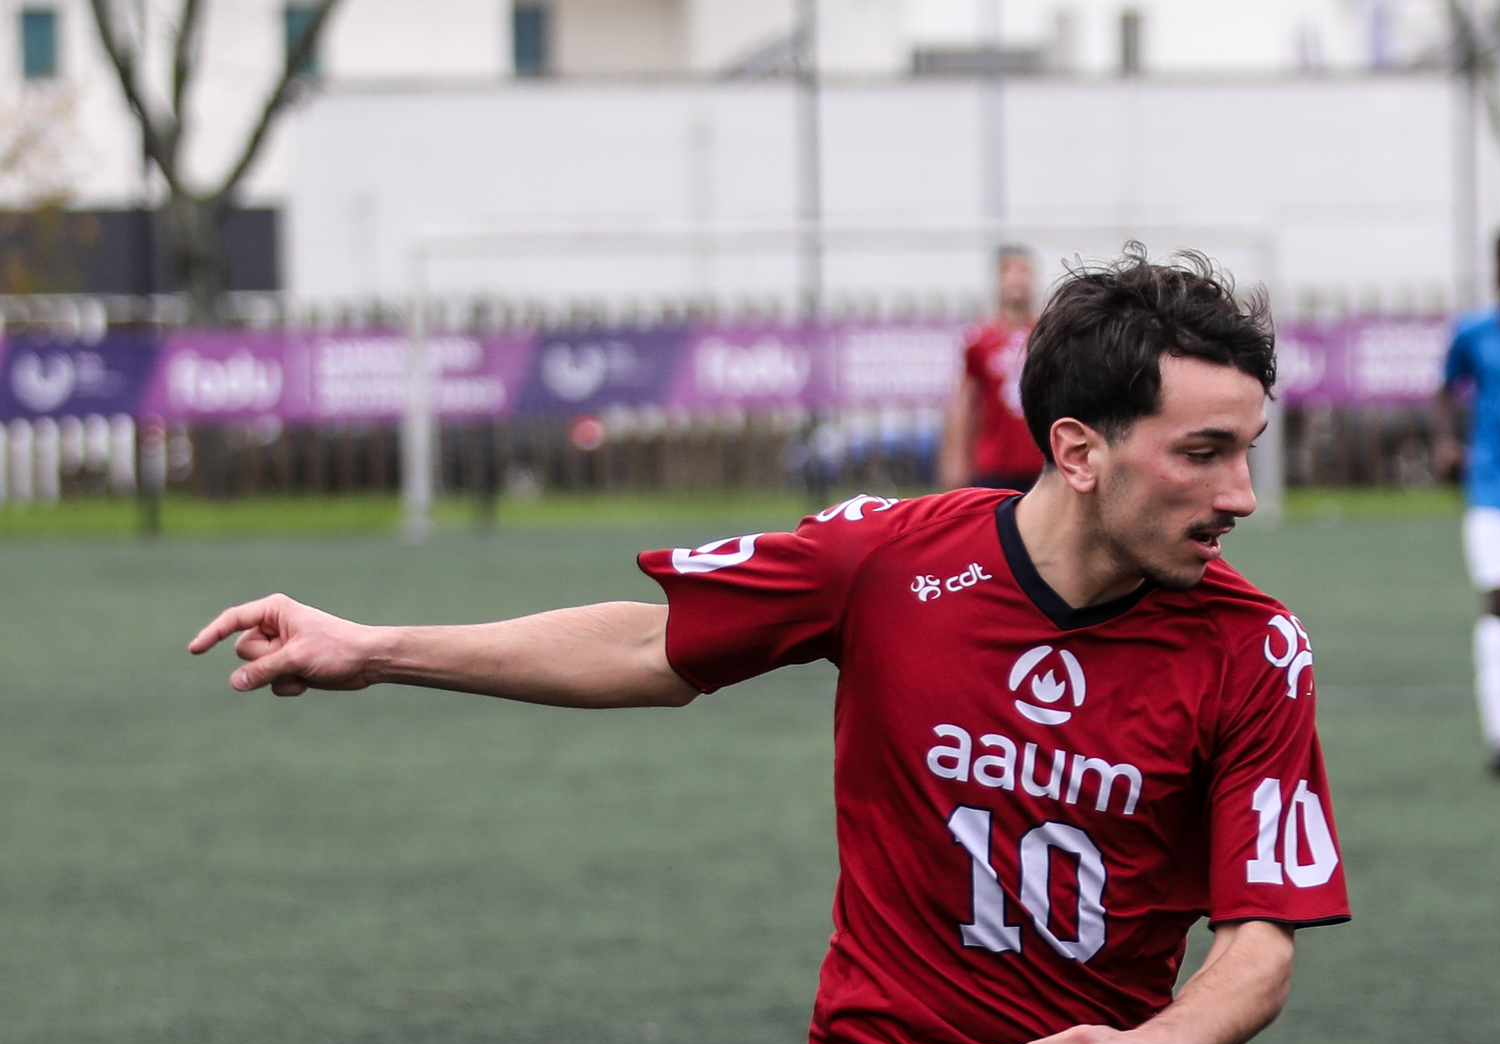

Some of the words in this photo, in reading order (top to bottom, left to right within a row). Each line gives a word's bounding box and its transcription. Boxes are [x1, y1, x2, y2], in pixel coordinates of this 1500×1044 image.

[945, 562, 993, 592] cdt
[927, 723, 1142, 815] aaum
[1246, 777, 1339, 887] 10
[947, 804, 1107, 963] 10
